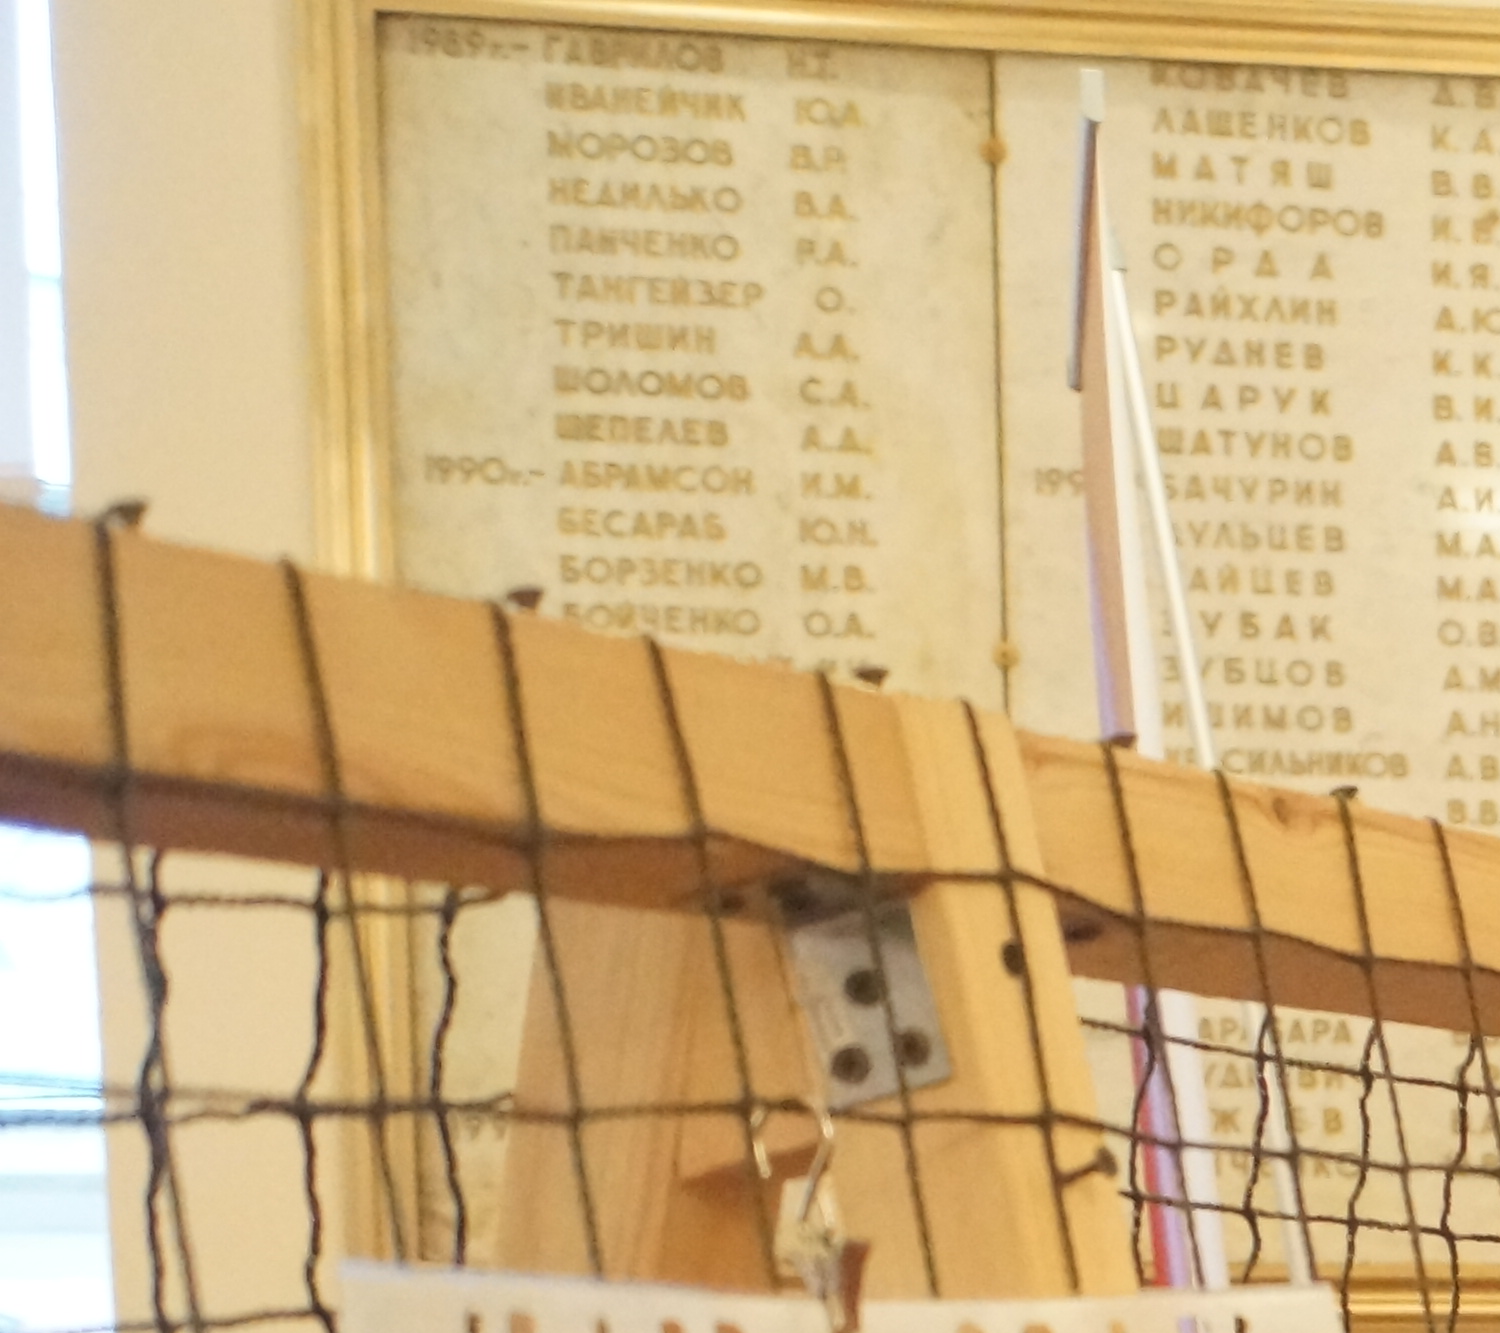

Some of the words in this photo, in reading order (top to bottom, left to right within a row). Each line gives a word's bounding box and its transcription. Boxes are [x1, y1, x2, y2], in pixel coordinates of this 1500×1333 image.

[548, 131, 733, 167] МОРОЗОВ
[1153, 152, 1333, 190] МАТЯШ
[1152, 199, 1384, 237] НИКИФОРОВ
[1153, 242, 1333, 280] ОРДА
[1154, 286, 1338, 326] РАЙХЛИН
[1155, 335, 1324, 370] РУДНЕВ
[554, 367, 750, 403] ШОЛОМОВ
[1155, 384, 1331, 417] ЦАРУК
[1156, 428, 1353, 462] ШАТУНОВ
[559, 460, 756, 496] АБРАМСОН
[558, 507, 725, 541] БЕСАРАБ
[560, 555, 763, 590] БОРЗЕНКО
